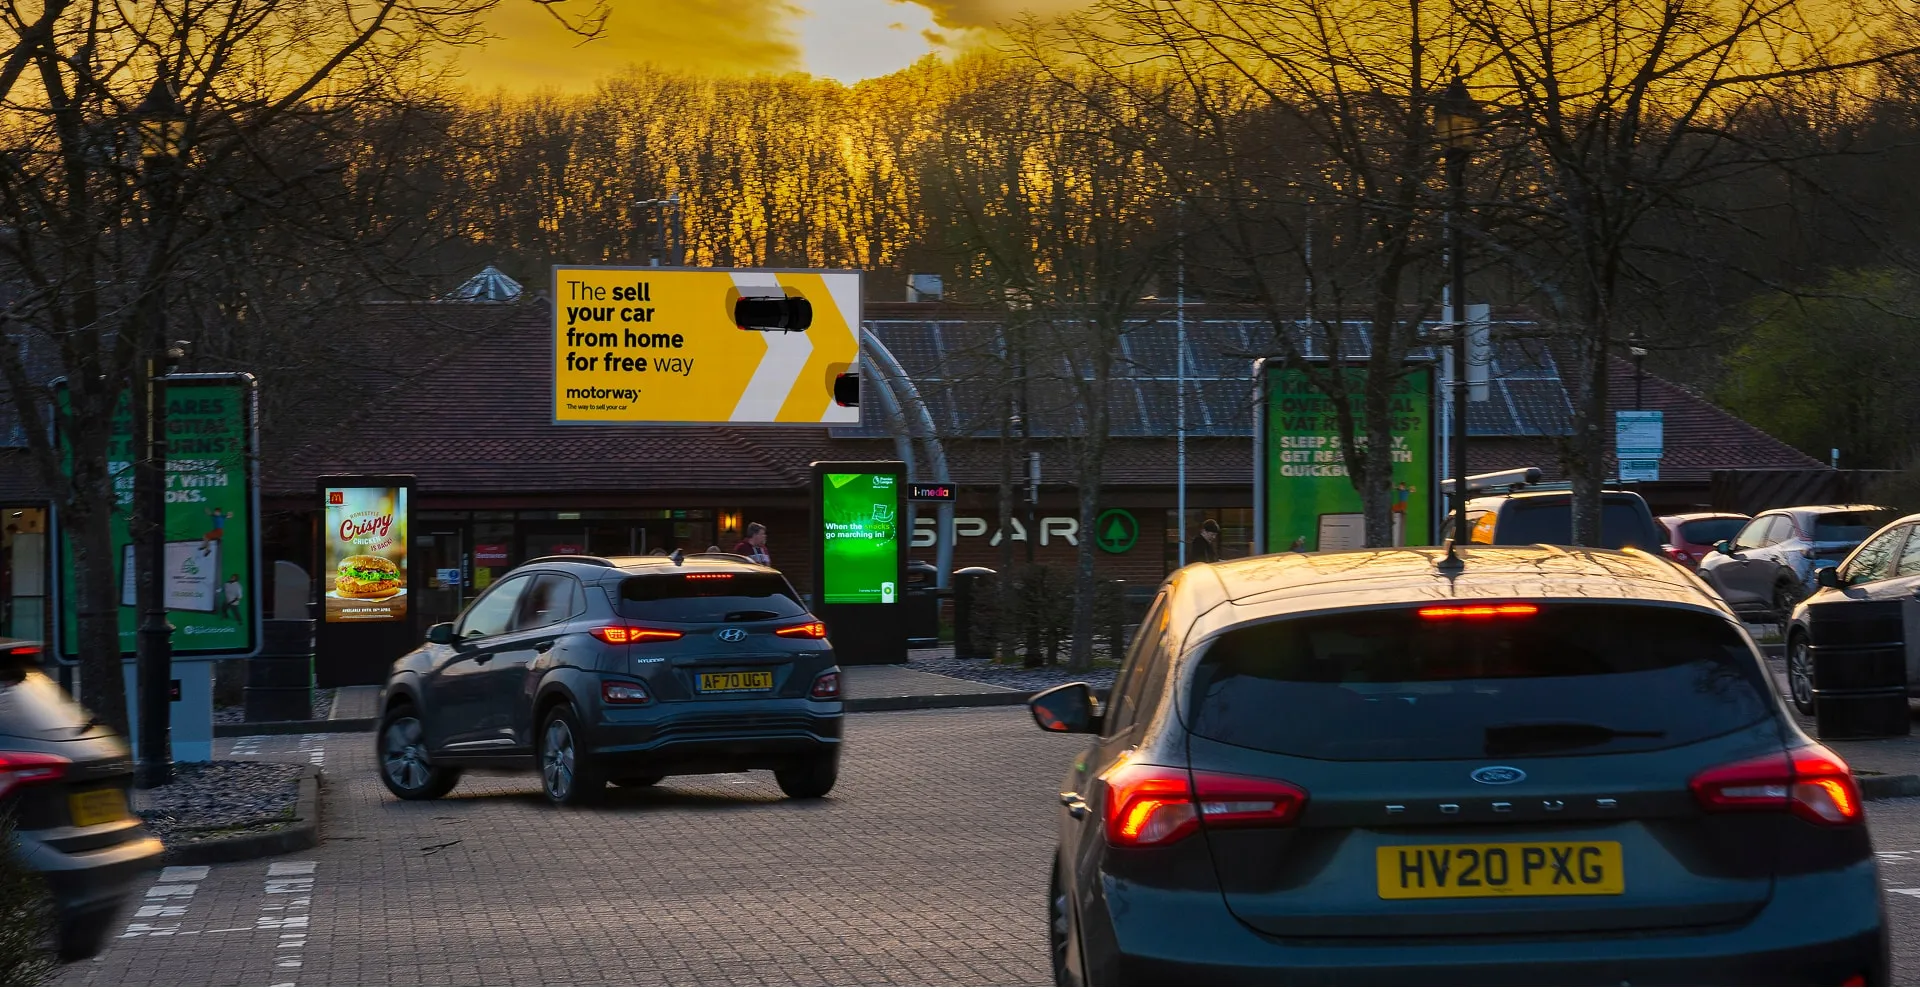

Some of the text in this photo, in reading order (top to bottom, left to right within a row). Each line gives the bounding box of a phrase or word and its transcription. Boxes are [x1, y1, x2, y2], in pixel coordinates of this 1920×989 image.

[567, 280, 651, 302] The sell
[566, 306, 656, 326] your car
[566, 327, 684, 348] from home
[566, 351, 694, 377] for free way
[566, 386, 639, 403] motorway
[1280, 436, 1327, 448] SLEEP
[1280, 451, 1311, 462] GET
[1390, 450, 1413, 463] TH
[339, 513, 393, 541] Crispy
[849, 522, 863, 530] the
[911, 517, 1080, 548] SPAR
[352, 536, 382, 546] CHICKEN
[837, 531, 873, 539] marching
[703, 672, 770, 689] AF70 UGT
[1385, 798, 1618, 814] FOCUS
[1399, 845, 1605, 889] HV20 PXG
